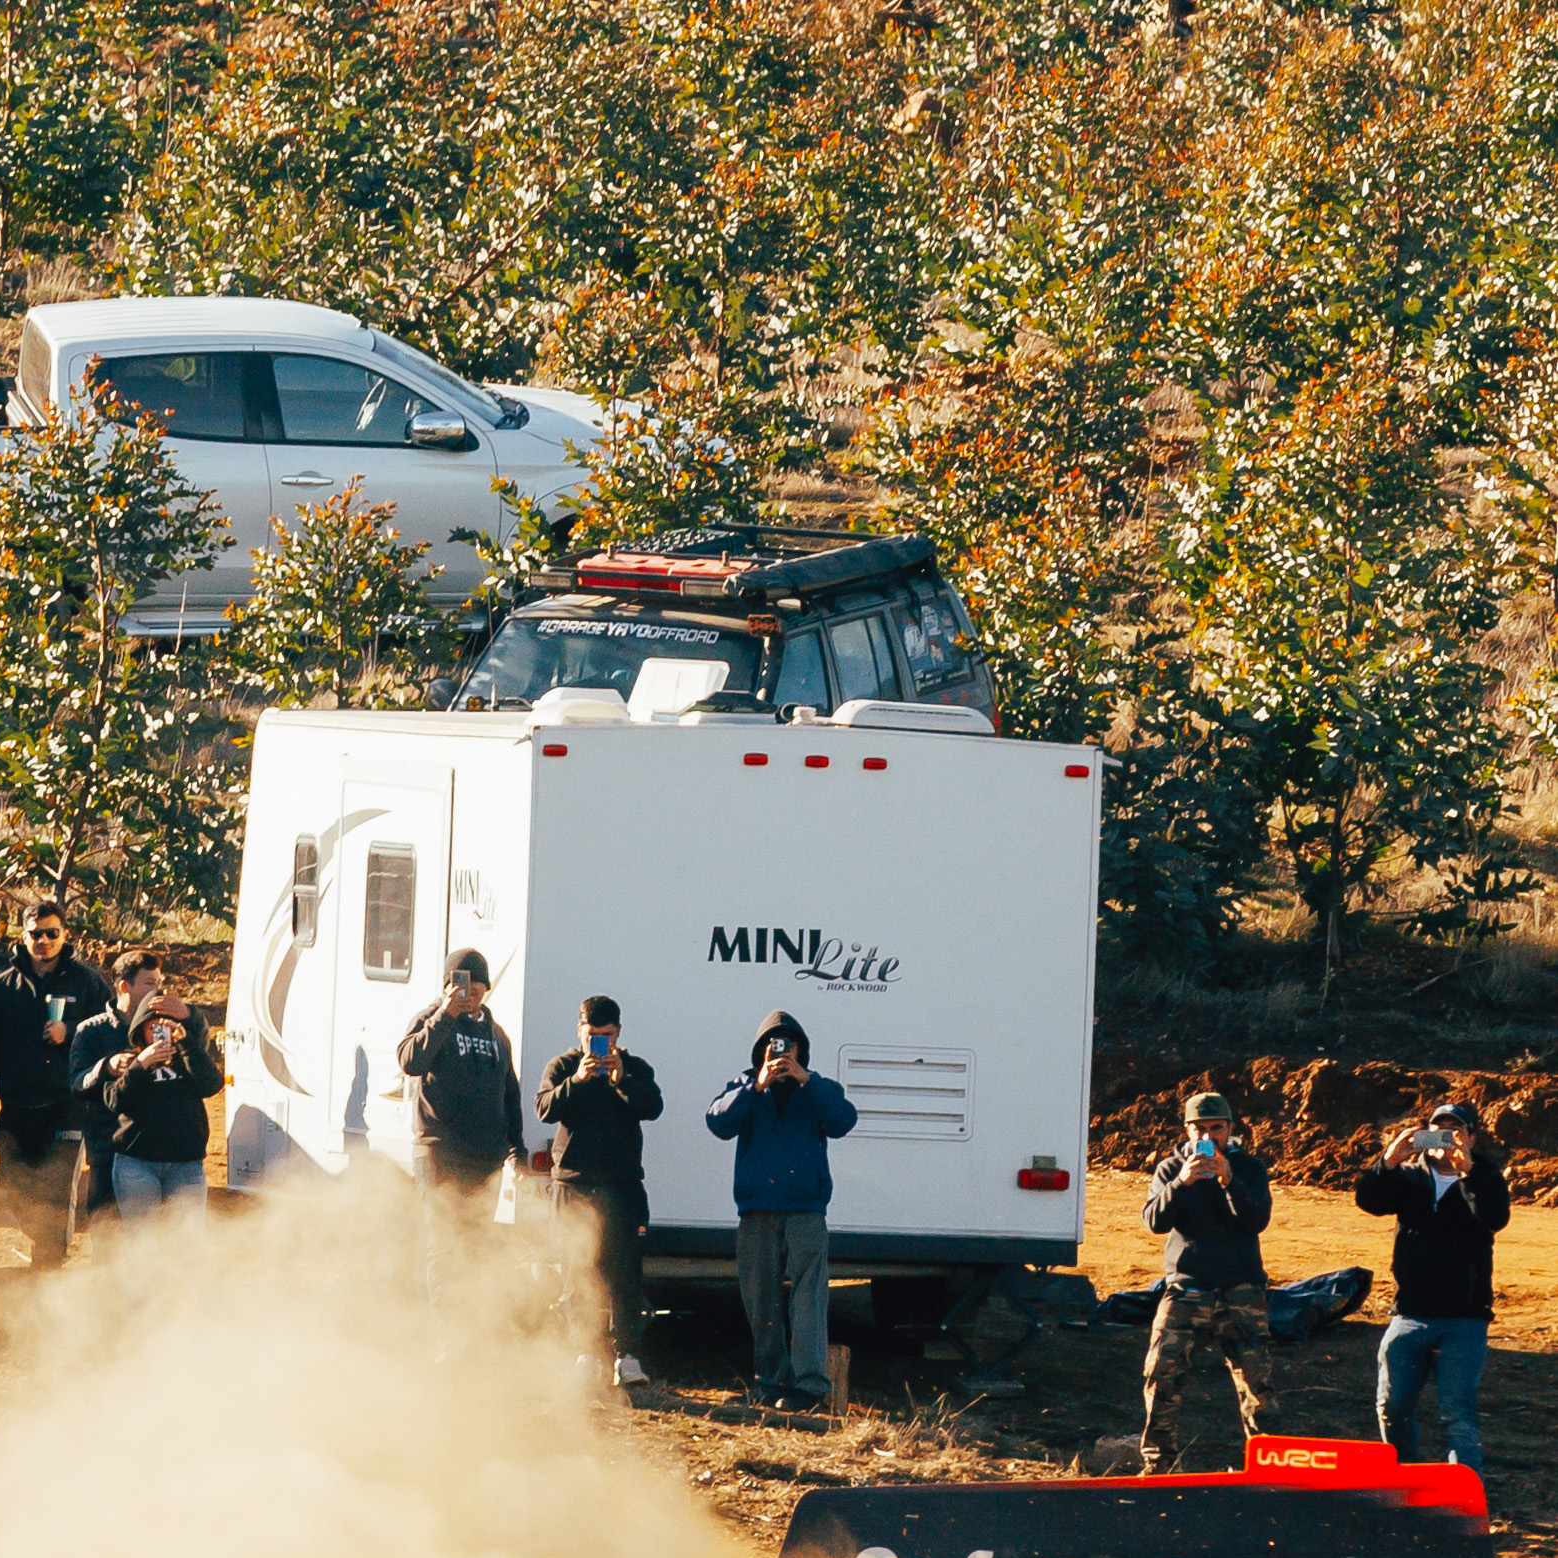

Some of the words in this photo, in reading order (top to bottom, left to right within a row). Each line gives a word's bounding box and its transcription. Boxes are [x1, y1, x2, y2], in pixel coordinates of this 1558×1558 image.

[708, 926, 821, 965] MINI
[794, 937, 903, 983] Lite
[826, 982, 888, 993] ROCKWOOD
[1257, 1448, 1337, 1469] WRC
